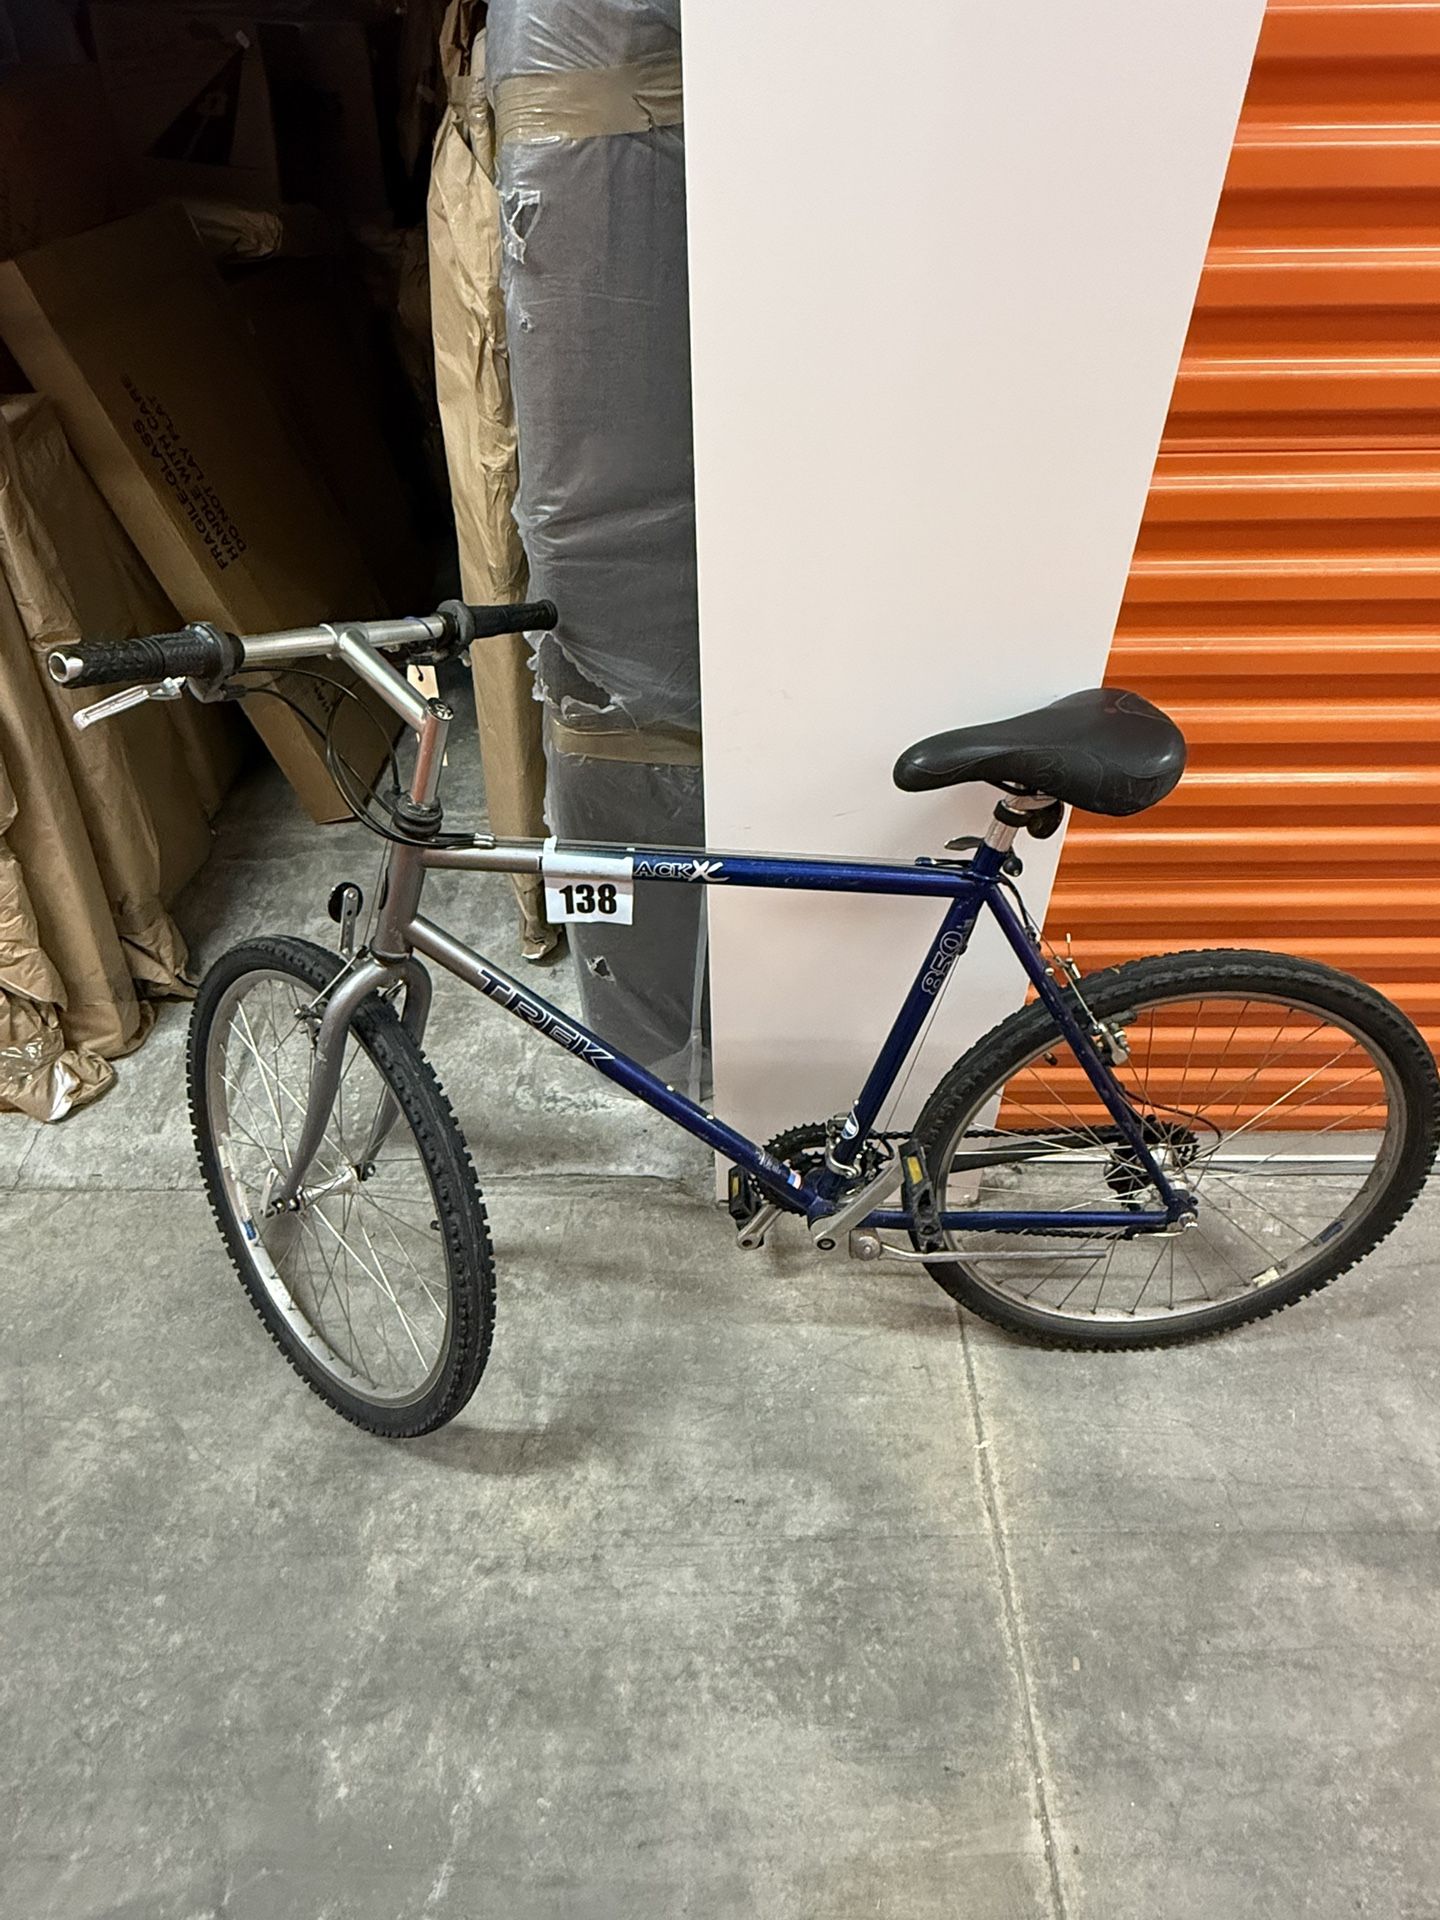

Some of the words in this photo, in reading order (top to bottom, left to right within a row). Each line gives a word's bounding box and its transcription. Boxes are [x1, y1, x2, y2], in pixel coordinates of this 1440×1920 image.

[120, 373, 159, 431] CARE
[147, 395, 180, 442] FLAT
[159, 434, 192, 485] WITH
[179, 446, 205, 482] LAY
[190, 486, 240, 561] HANDLE
[205, 484, 229, 524] NOT
[227, 526, 247, 553] DO
[634, 861, 692, 879] ACK
[559, 884, 617, 915] 138
[921, 931, 963, 995] 850
[478, 968, 616, 1071] TREK
